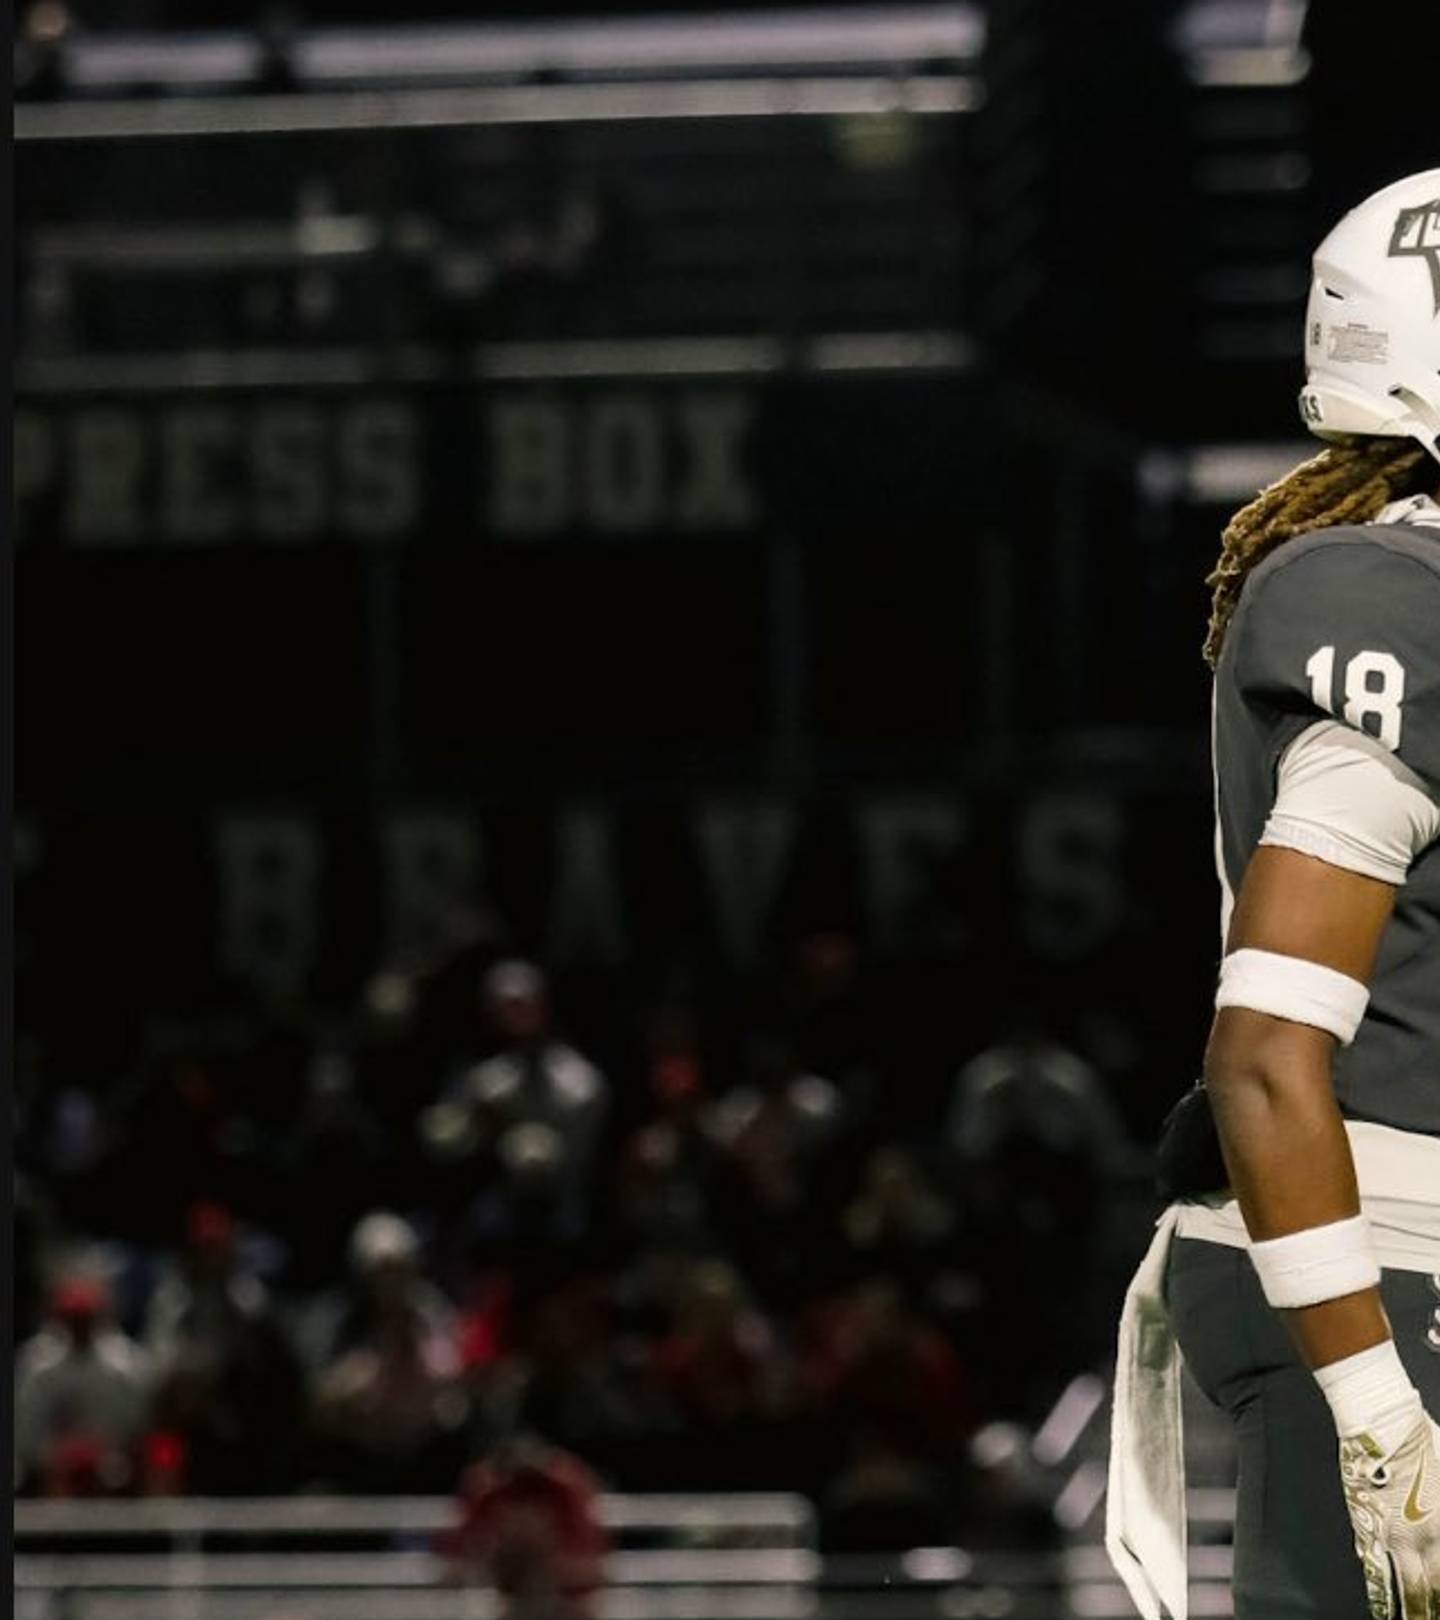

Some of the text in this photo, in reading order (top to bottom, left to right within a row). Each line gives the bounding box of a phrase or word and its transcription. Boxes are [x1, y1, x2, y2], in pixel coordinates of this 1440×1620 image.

[488, 398, 757, 537] BOX
[1306, 646, 1405, 751] 18
[215, 800, 1127, 988] BRAVES
